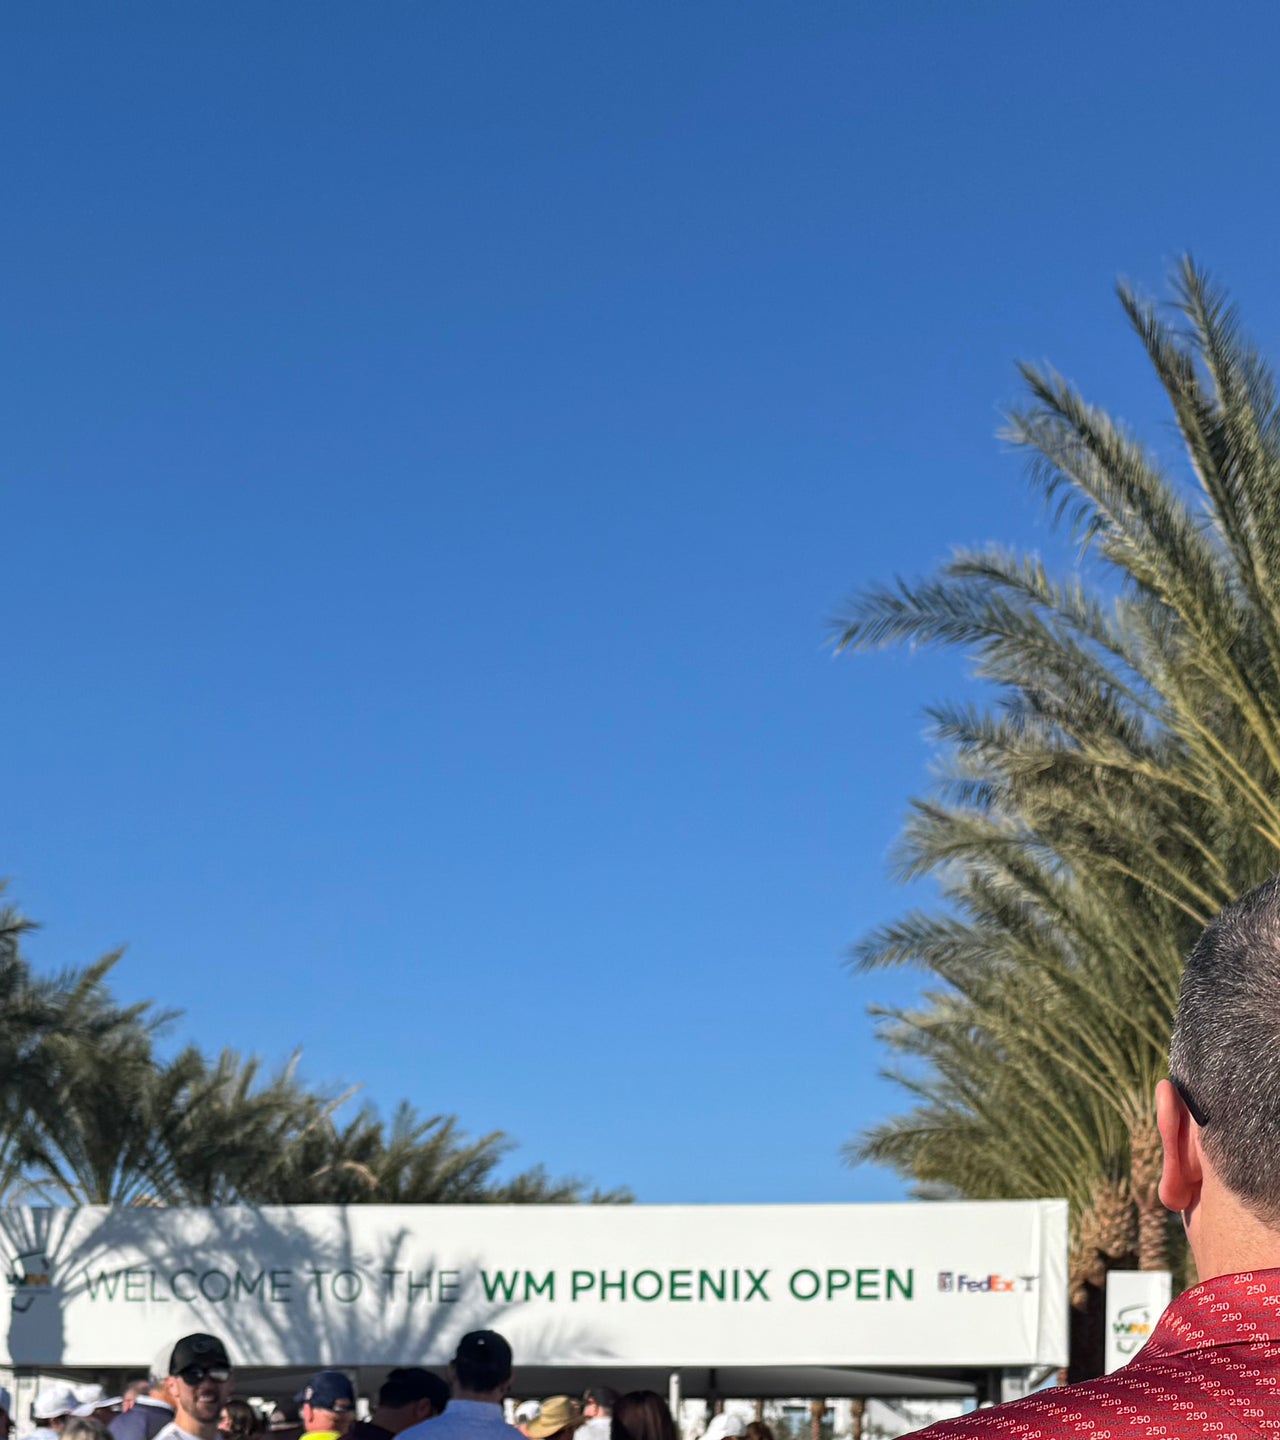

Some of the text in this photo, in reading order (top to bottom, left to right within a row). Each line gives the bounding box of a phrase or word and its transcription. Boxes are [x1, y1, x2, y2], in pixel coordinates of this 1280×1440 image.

[86, 1267, 915, 1303] WELCOME TO THE WM PHOENIX OPEN
[958, 1273, 1015, 1293] FedEx
[1202, 1421, 1224, 1432] 250
